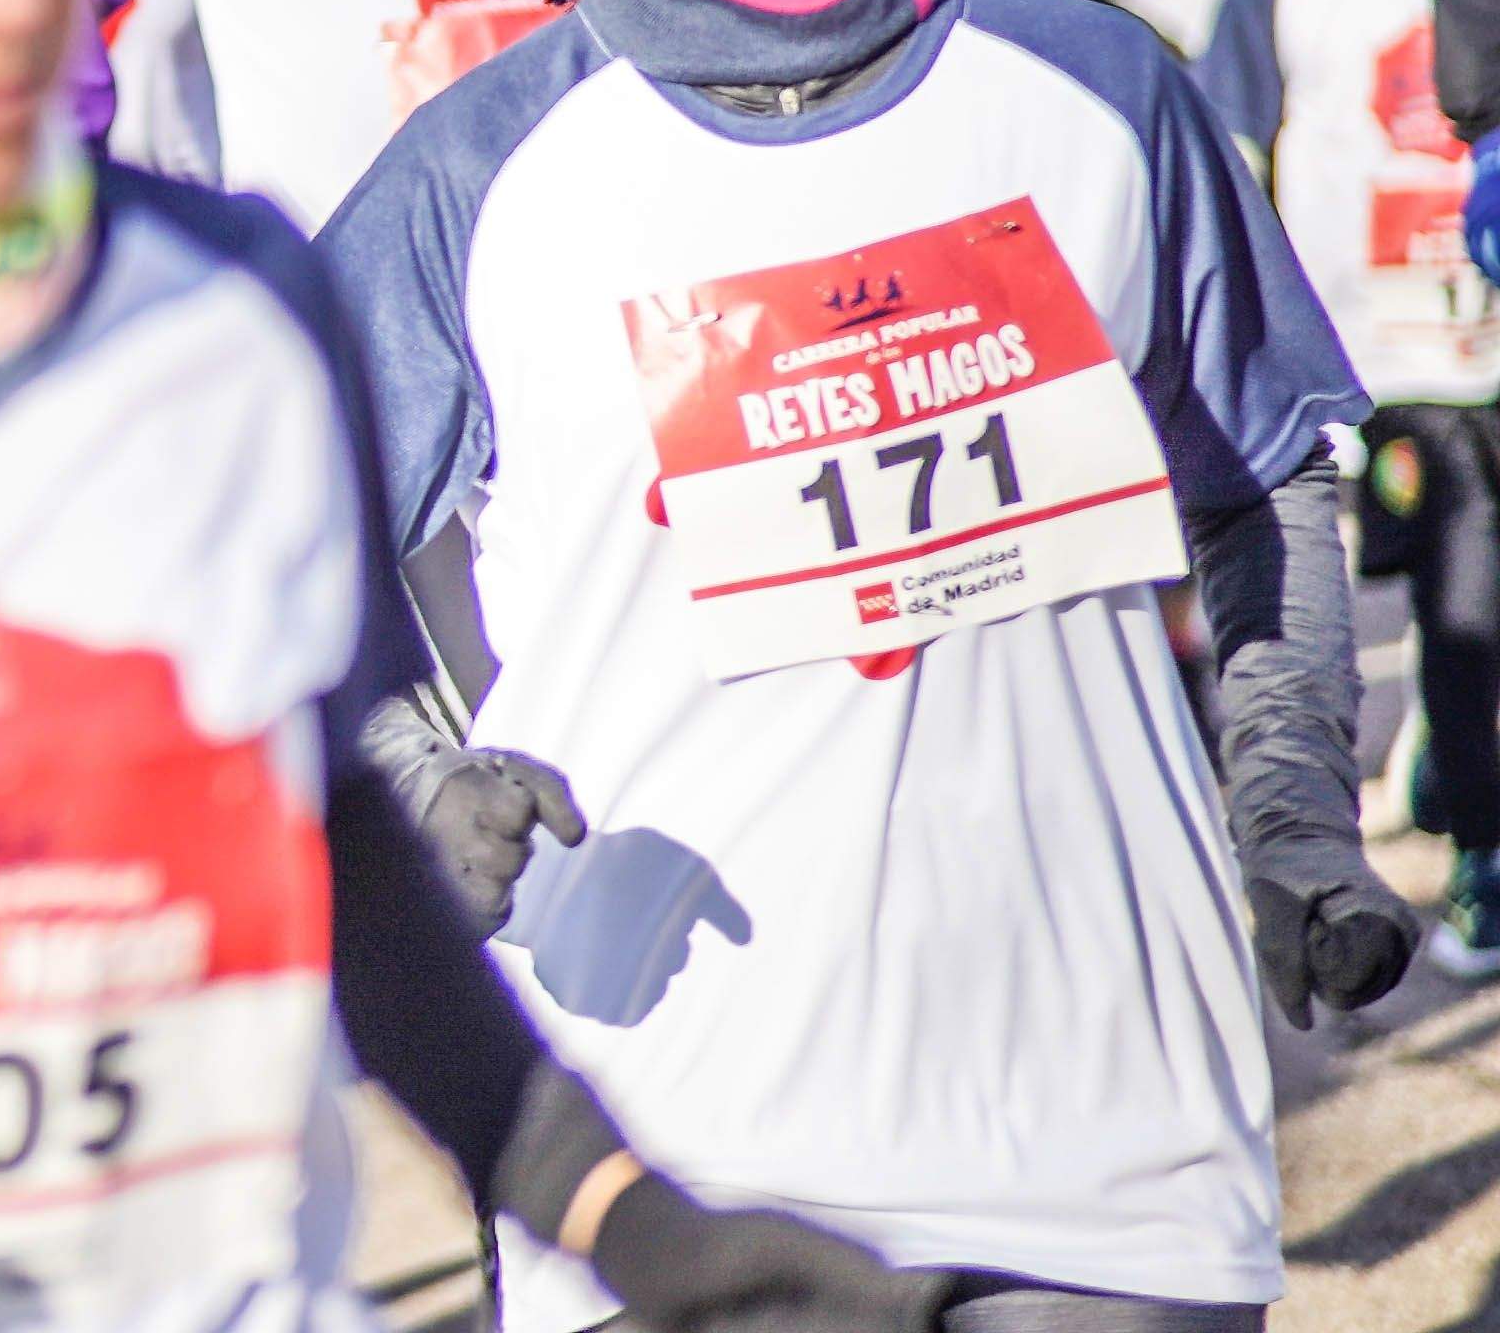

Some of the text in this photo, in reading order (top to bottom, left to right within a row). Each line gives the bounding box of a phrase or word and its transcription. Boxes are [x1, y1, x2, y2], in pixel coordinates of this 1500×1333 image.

[772, 304, 983, 374] CARRERA POPULAR
[737, 323, 1037, 451] REYES MAGOS
[800, 412, 1024, 551] 171
[901, 544, 1021, 591] Comunidad
[943, 564, 1026, 603] Madrid
